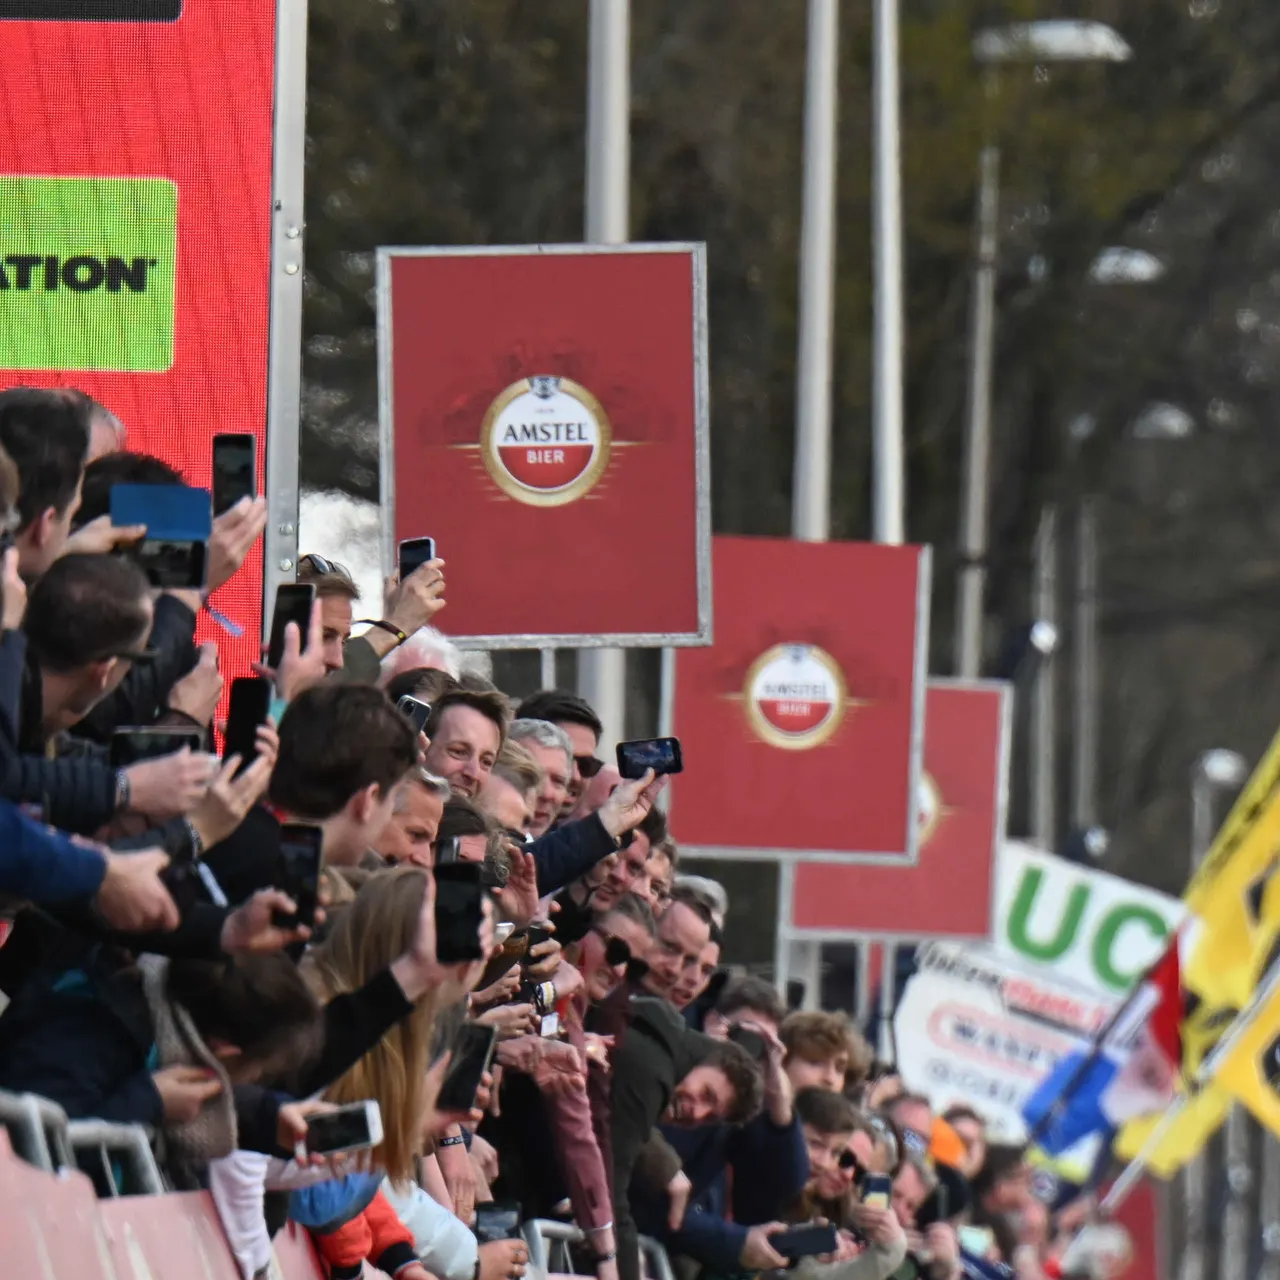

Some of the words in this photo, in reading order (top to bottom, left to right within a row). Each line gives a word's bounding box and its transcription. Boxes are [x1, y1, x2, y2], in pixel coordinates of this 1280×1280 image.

[0, 254, 148, 292] TION
[503, 422, 598, 442] AMSTEL
[526, 449, 565, 464] BIER
